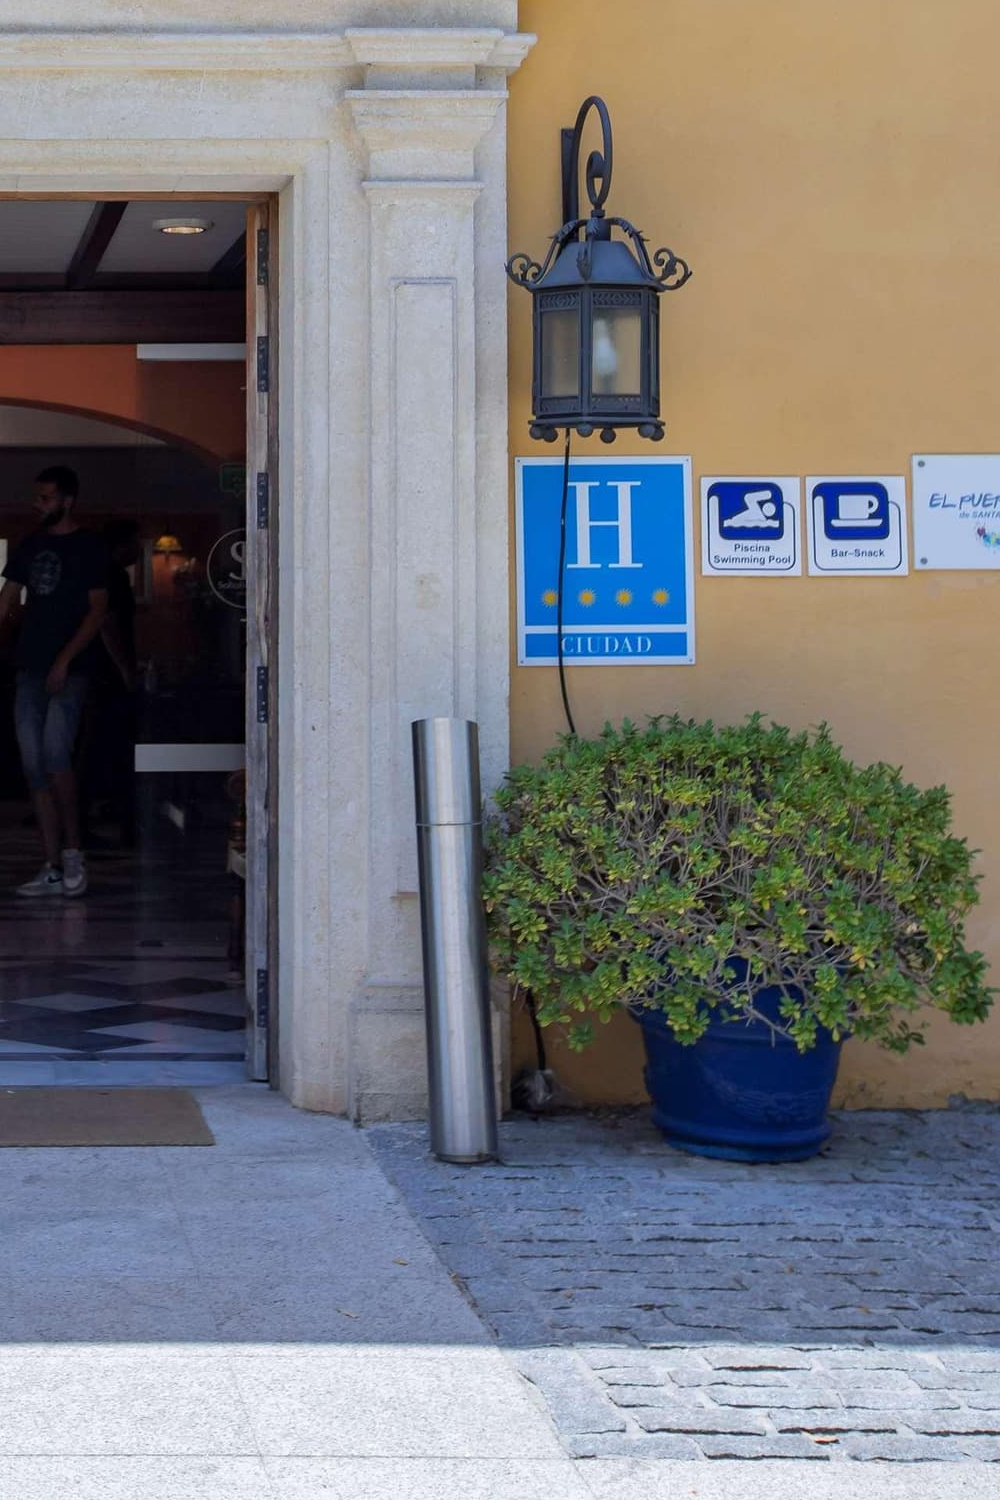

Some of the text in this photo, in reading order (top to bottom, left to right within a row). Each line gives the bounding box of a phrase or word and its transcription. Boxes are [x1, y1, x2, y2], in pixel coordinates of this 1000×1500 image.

[929, 493, 956, 508] EL
[566, 481, 643, 568] H
[734, 543, 770, 552] Piscina
[831, 548, 885, 557] Bar-Snack
[713, 555, 791, 565] Swimming Pool
[561, 636, 652, 653] CIUDAD
